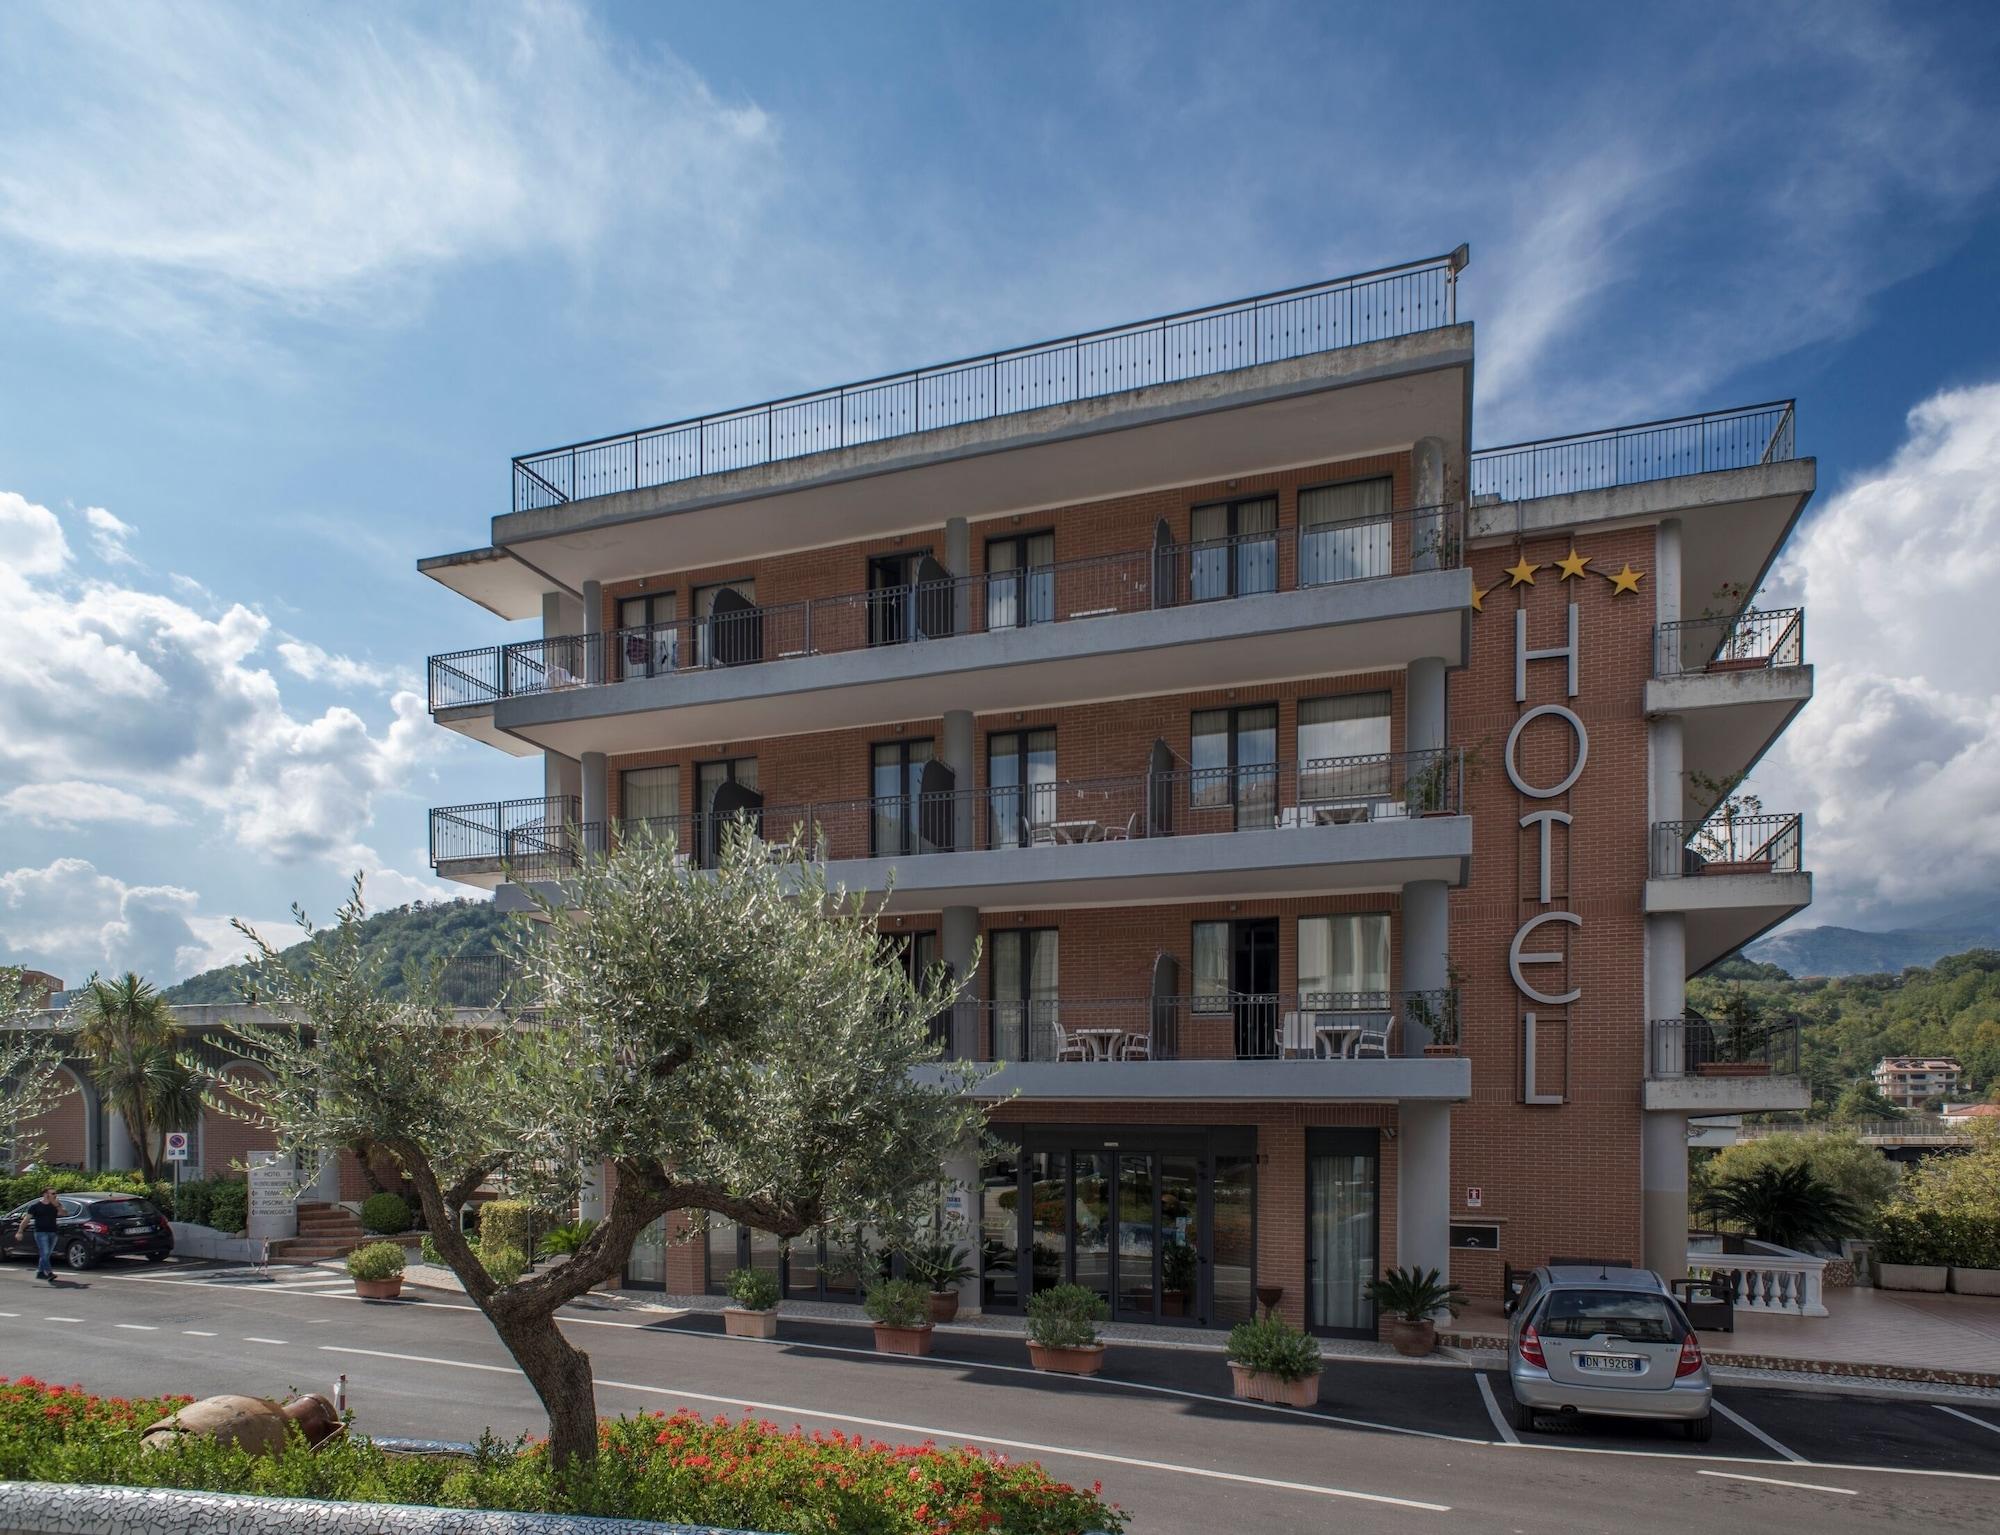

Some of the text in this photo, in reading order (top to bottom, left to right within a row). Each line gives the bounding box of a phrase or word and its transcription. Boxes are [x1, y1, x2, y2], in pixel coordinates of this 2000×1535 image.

[1504, 602, 1589, 1105] HOTEL
[1586, 1356, 1634, 1370] DN 192CB
